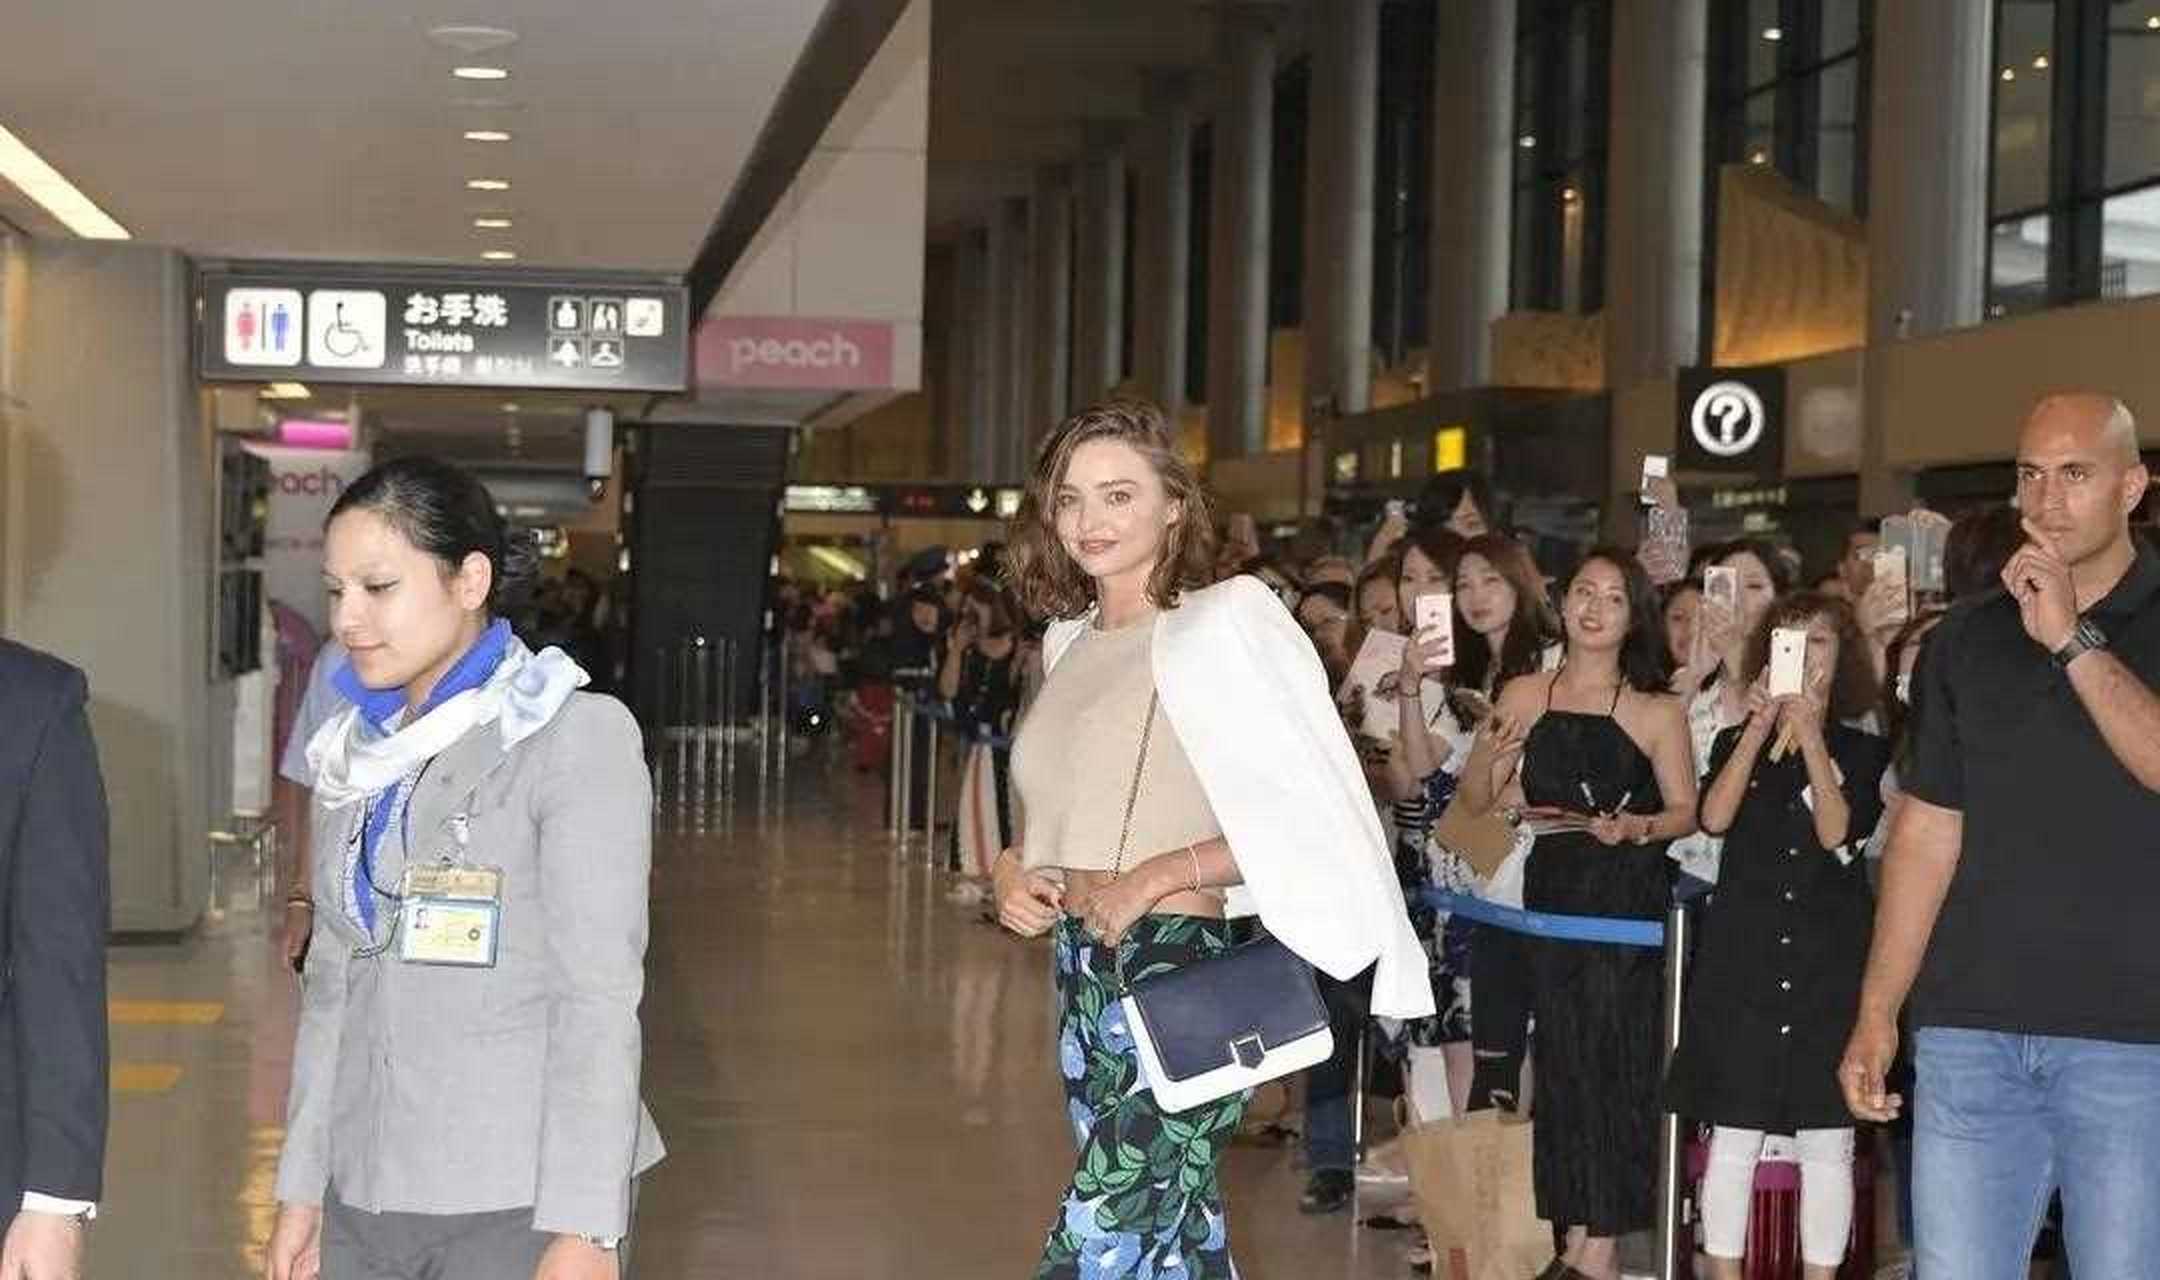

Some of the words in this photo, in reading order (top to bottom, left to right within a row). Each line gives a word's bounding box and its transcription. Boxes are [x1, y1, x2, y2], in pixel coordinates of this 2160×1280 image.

[404, 292, 509, 326] お手洗
[404, 328, 475, 352] Toilets
[729, 332, 861, 374] peach
